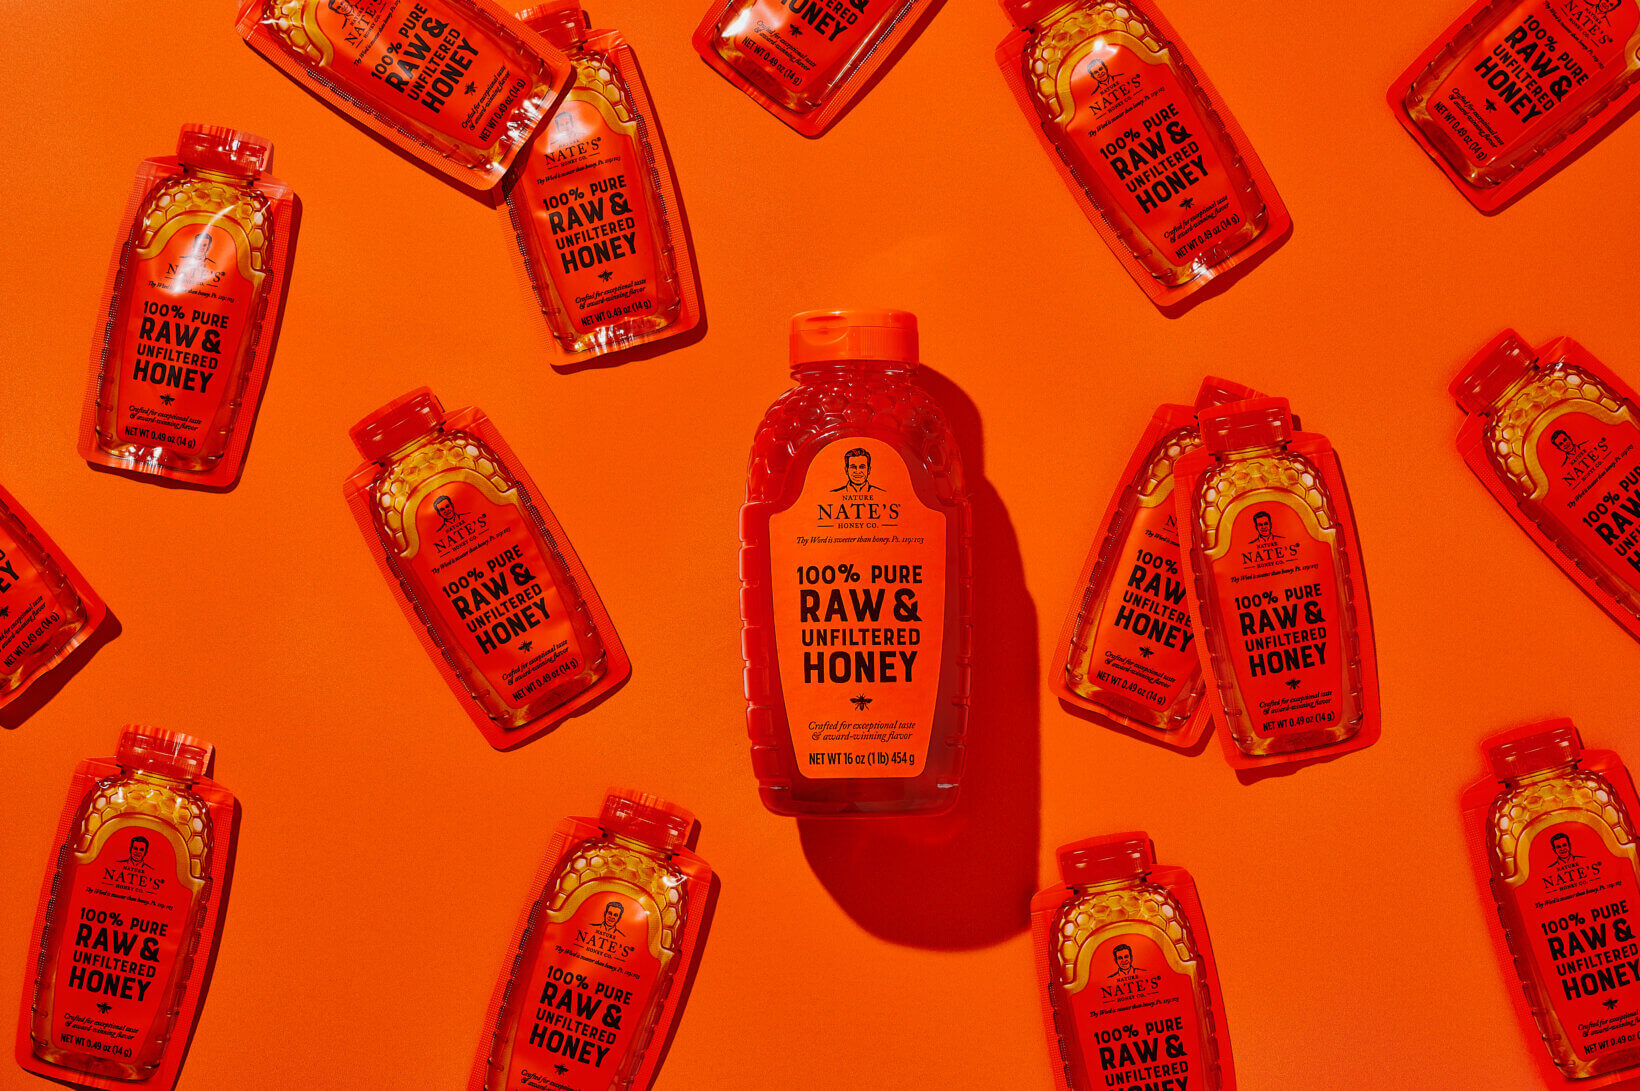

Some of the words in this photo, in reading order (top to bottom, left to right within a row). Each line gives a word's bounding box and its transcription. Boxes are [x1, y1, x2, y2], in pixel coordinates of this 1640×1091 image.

[781, 0, 848, 42] ONEY
[371, 42, 402, 80] 100%
[398, 3, 428, 38] PURE
[384, 33, 431, 93] RAW
[421, 17, 449, 38] &
[1523, 14, 1557, 52] 100%
[1557, 52, 1589, 86] PURE
[407, 28, 460, 101] UNFILTERED
[421, 37, 479, 114] HONEY
[1493, 44, 1555, 111] UNFILTERED
[1504, 25, 1560, 78] RAW
[1549, 75, 1572, 102] &
[1474, 56, 1543, 123] HONEY
[1100, 128, 1141, 159] 100%
[1142, 103, 1179, 132] PURE
[1110, 131, 1166, 180] RAW
[1166, 121, 1192, 144] &
[1125, 141, 1199, 193] UNFILTERED
[543, 187, 584, 211] 100%
[590, 175, 627, 196] PURE
[1135, 154, 1208, 214] HONEY
[549, 197, 603, 235] RAW
[609, 192, 633, 216] &
[556, 217, 635, 250] UNFILTERED
[1175, 245, 1188, 259] NET
[1186, 239, 1199, 250] WT
[1197, 230, 1213, 244] 0.49
[1212, 226, 1221, 235] oz
[561, 231, 636, 274] HONEY
[144, 301, 185, 319] 100%
[192, 310, 229, 329] PURE
[581, 315, 594, 327] NET
[594, 312, 606, 322] WT
[606, 307, 622, 319] 0.49
[623, 305, 632, 314] oz
[139, 316, 200, 348] RAW
[202, 329, 222, 354] &
[137, 343, 218, 370] UNFILTERED
[133, 358, 213, 393] HONEY
[125, 426, 138, 436] NET
[139, 428, 150, 438] WT
[151, 431, 166, 441] 0.49
[1582, 492, 1620, 527] 100%
[1619, 465, 1640, 492] PUR
[442, 568, 484, 598] 100%
[487, 544, 523, 573] PURE
[797, 564, 860, 585] 100%
[871, 565, 923, 584] PURE
[1137, 549, 1178, 575] 100%
[451, 571, 509, 620] RAW
[510, 563, 536, 586] &
[1128, 564, 1186, 605] RAW
[1235, 590, 1278, 610] 100%
[1284, 583, 1322, 602] PURE
[466, 584, 542, 633] UNFILTERED
[800, 589, 885, 623] RAW
[894, 589, 922, 621] &
[1123, 590, 1191, 628] UNFILTERE
[1239, 604, 1297, 636] RAW
[1304, 600, 1326, 624] &
[475, 597, 550, 655] HONEY
[802, 628, 920, 646] UNFILTERED
[1114, 605, 1194, 653] HONEY
[1245, 627, 1326, 652] UNFILTERED
[3, 653, 17, 667] NET
[13, 645, 26, 657] WT
[22, 633, 37, 648] 0.49
[35, 627, 44, 636] oz
[1249, 642, 1326, 677] HONEY
[512, 688, 526, 701] NET
[524, 682, 537, 694] WT
[535, 673, 551, 687] 0.49
[551, 669, 560, 678] oz
[804, 651, 917, 683] HONEY
[1096, 670, 1111, 682] NET
[1110, 675, 1122, 686] WT
[1121, 680, 1138, 692] 0.49
[1137, 688, 1146, 696] oz
[809, 721, 839, 732] Crafted
[837, 721, 852, 732] for
[853, 720, 897, 732] exceptional
[812, 732, 821, 740] &
[823, 731, 886, 742] award-winning
[886, 731, 912, 742] flavor
[809, 753, 825, 764] NET
[828, 753, 841, 764] WT
[843, 753, 853, 764] 16
[855, 755, 865, 764] oz
[891, 752, 907, 764] 454
[909, 754, 914, 765] g
[80, 907, 123, 926] 100%
[130, 917, 168, 937] PURE
[1541, 912, 1585, 935] 100%
[1591, 900, 1629, 922] PURE
[75, 923, 138, 956] RAW
[140, 937, 159, 962] &
[1547, 923, 1606, 961] RAW
[1612, 918, 1636, 942] &
[73, 950, 156, 978] UNFILTERED
[1556, 943, 1638, 976] UNFILTERED
[68, 965, 151, 1002] HONEY
[547, 965, 589, 990] 100%
[595, 982, 633, 1005] PURE
[1562, 958, 1640, 1000] HONEY
[540, 981, 602, 1020] RAW
[602, 1004, 622, 1030] &
[60, 1033, 74, 1043] NET
[71, 1035, 85, 1046] WT
[86, 1039, 102, 1050] 0.49
[102, 1044, 111, 1052] oz
[536, 1008, 616, 1045] UNFILTERED
[1094, 1024, 1139, 1045] 100%
[1145, 1016, 1183, 1035] PURE
[529, 1023, 610, 1068] HONEY
[1099, 1037, 1158, 1071] RAW
[1165, 1034, 1188, 1058] &
[1105, 1061, 1188, 1086] UNFILTERED
